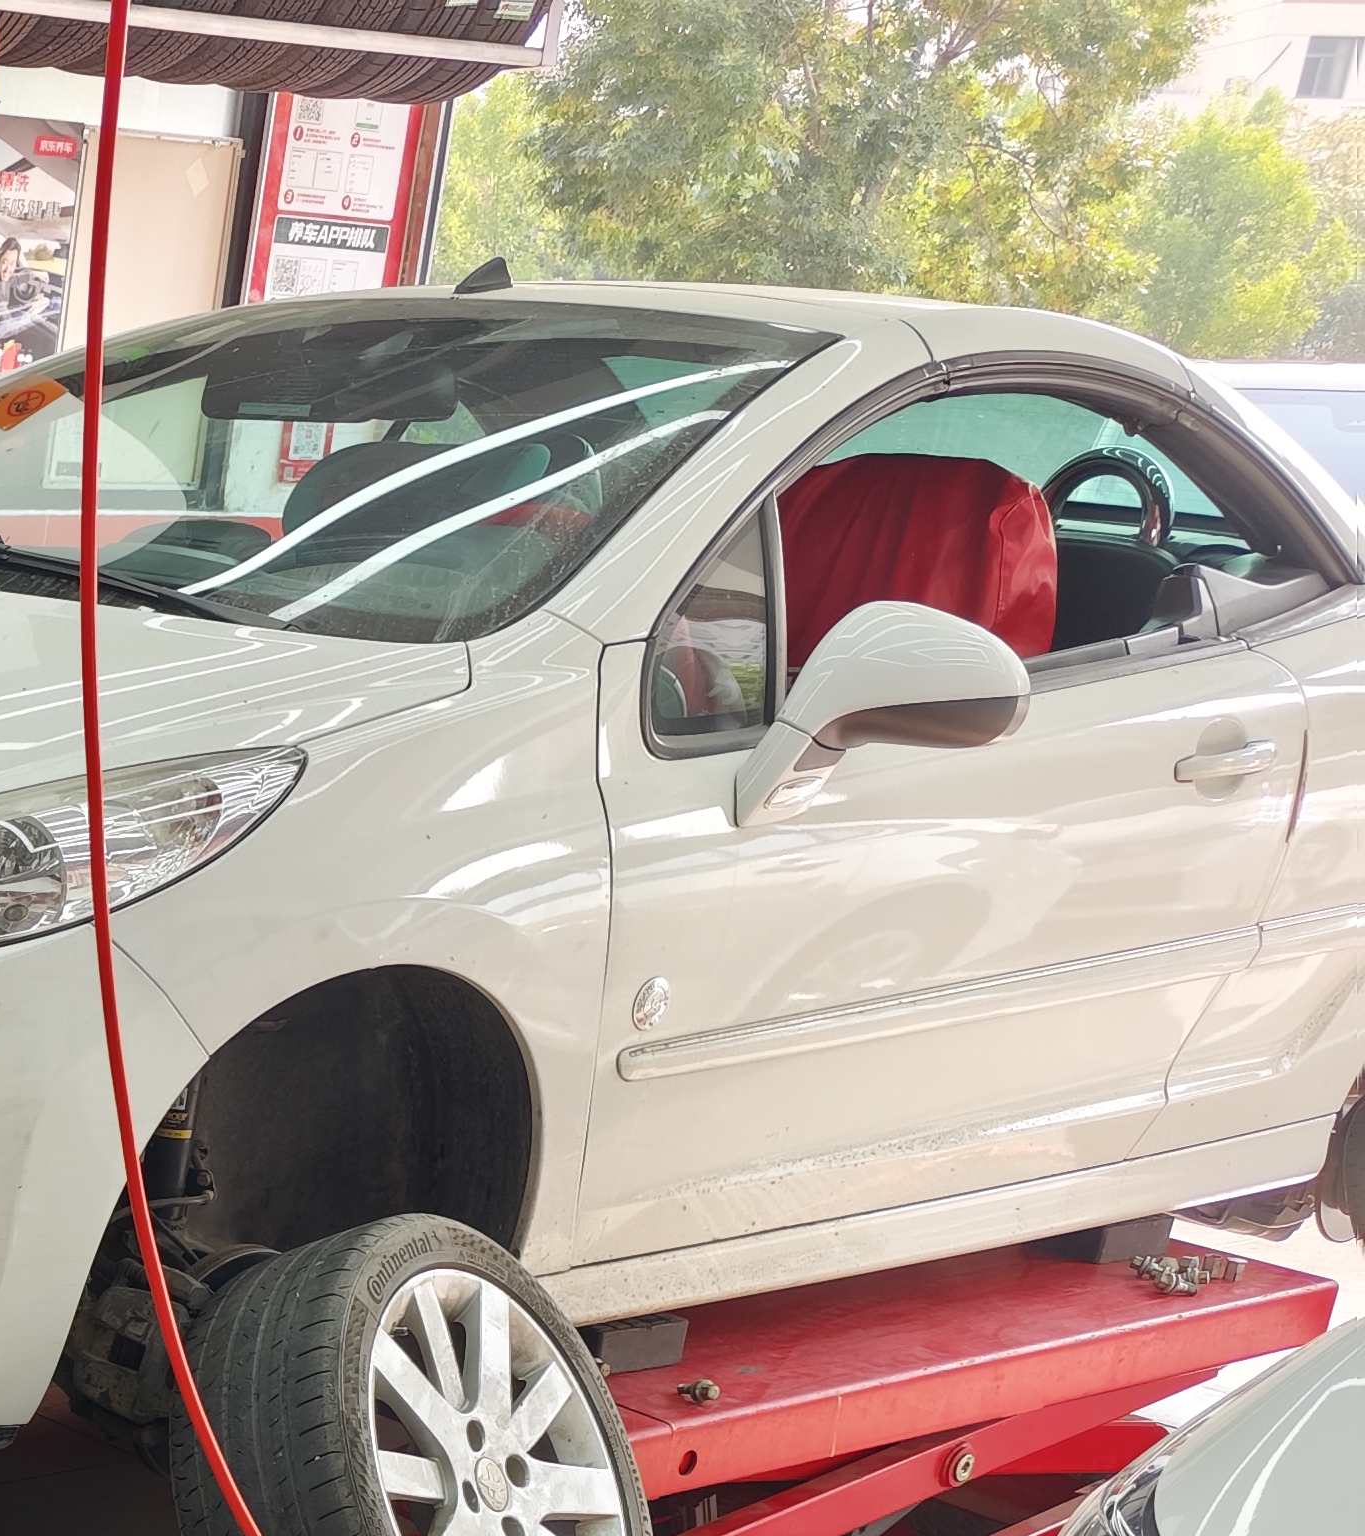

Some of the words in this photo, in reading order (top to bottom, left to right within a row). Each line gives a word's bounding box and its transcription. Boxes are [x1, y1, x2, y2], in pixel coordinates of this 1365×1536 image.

[39, 139, 73, 155] 京东养车
[288, 221, 376, 249] 养车APP排队
[366, 1231, 434, 1304] Continental
